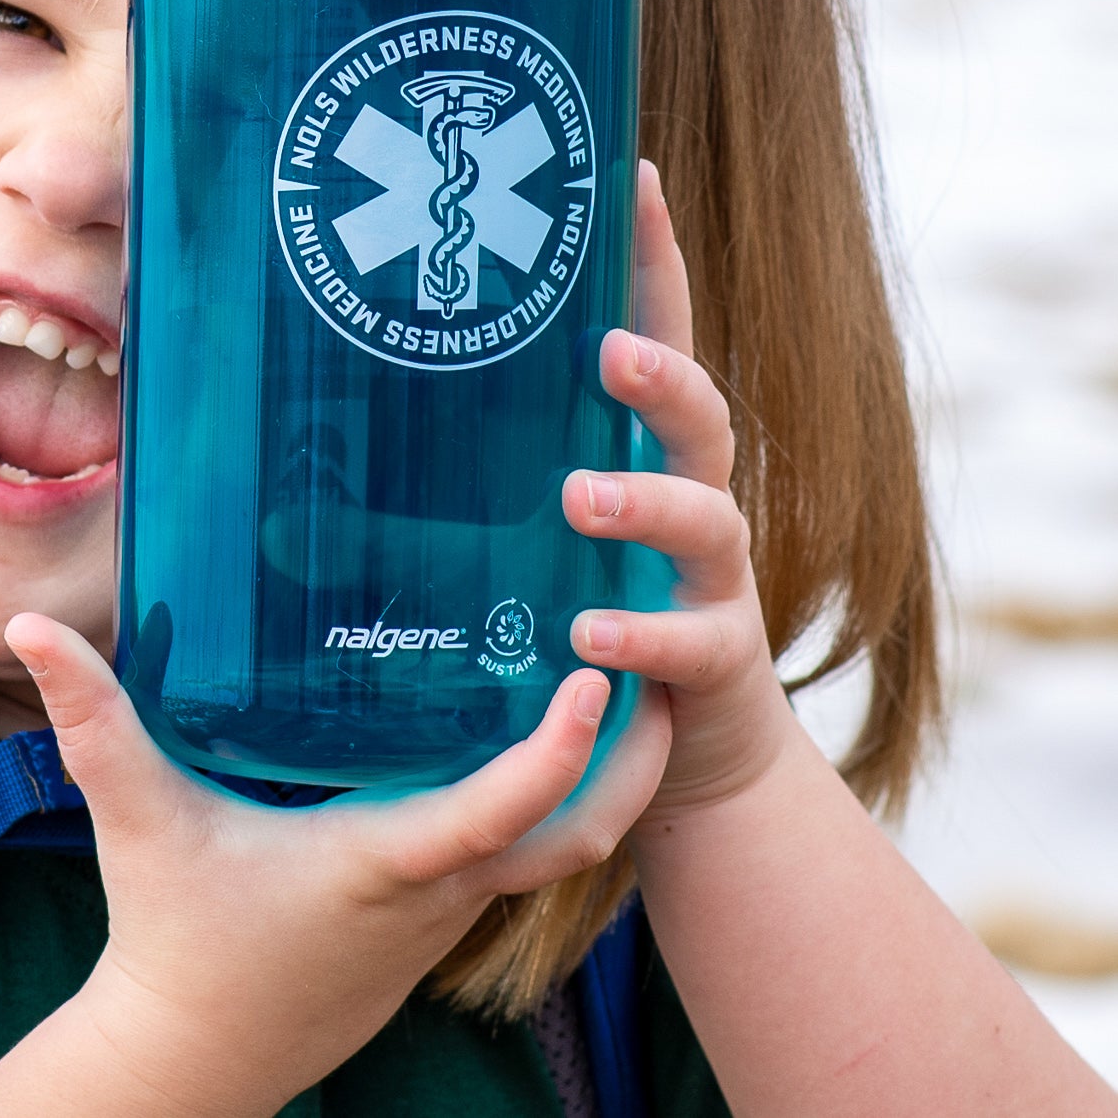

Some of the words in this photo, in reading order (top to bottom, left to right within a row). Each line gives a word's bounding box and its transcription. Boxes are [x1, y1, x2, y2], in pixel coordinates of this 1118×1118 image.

[290, 92, 340, 169] NOLS
[329, 26, 515, 96] WILDERNESS
[517, 45, 586, 168] MEDICINE
[289, 204, 381, 334] MEDICINE
[549, 202, 585, 281] NOLS
[383, 280, 556, 355] WILDERNESS
[477, 652, 538, 676] SUSTAIN
